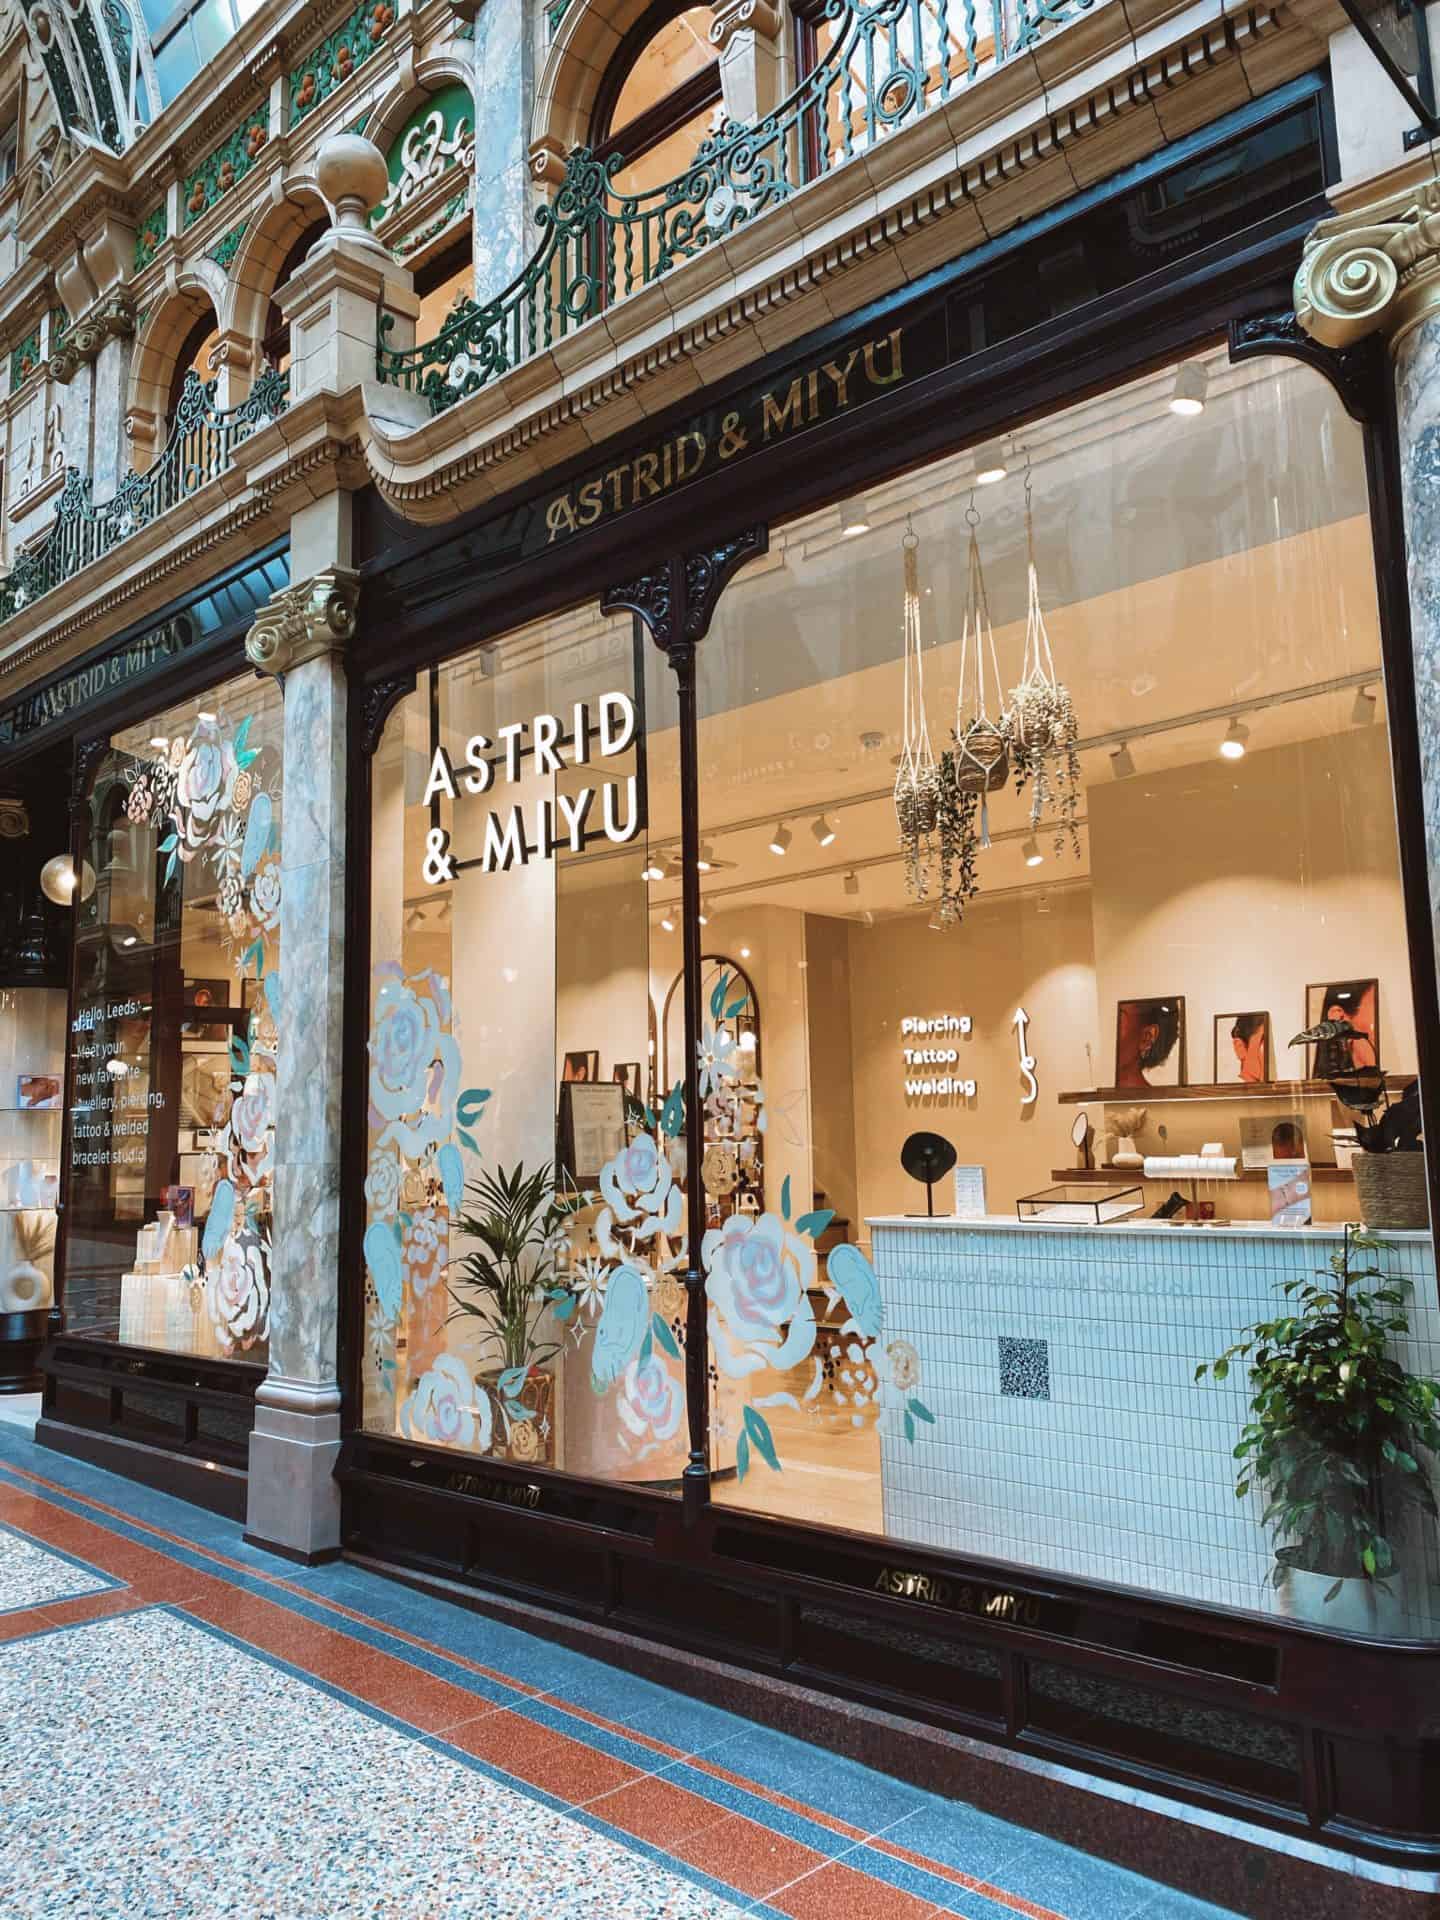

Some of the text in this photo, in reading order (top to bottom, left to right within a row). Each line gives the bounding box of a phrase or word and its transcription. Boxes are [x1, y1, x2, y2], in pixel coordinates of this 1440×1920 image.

[546, 328, 905, 544] ASTRID & MIYU
[110, 656, 121, 684] &
[422, 691, 636, 807] ASTRID
[422, 776, 638, 884] & MIYU
[901, 1015, 972, 1034] Piercing
[903, 1049, 958, 1064] Tattoo
[76, 1071, 95, 1085] new
[905, 1078, 976, 1096] Welding
[74, 1119, 149, 1138] tattoo & welded
[72, 1148, 111, 1165] bracelet
[874, 1568, 950, 1602] ASTRID
[979, 1590, 1041, 1624] MIYU
